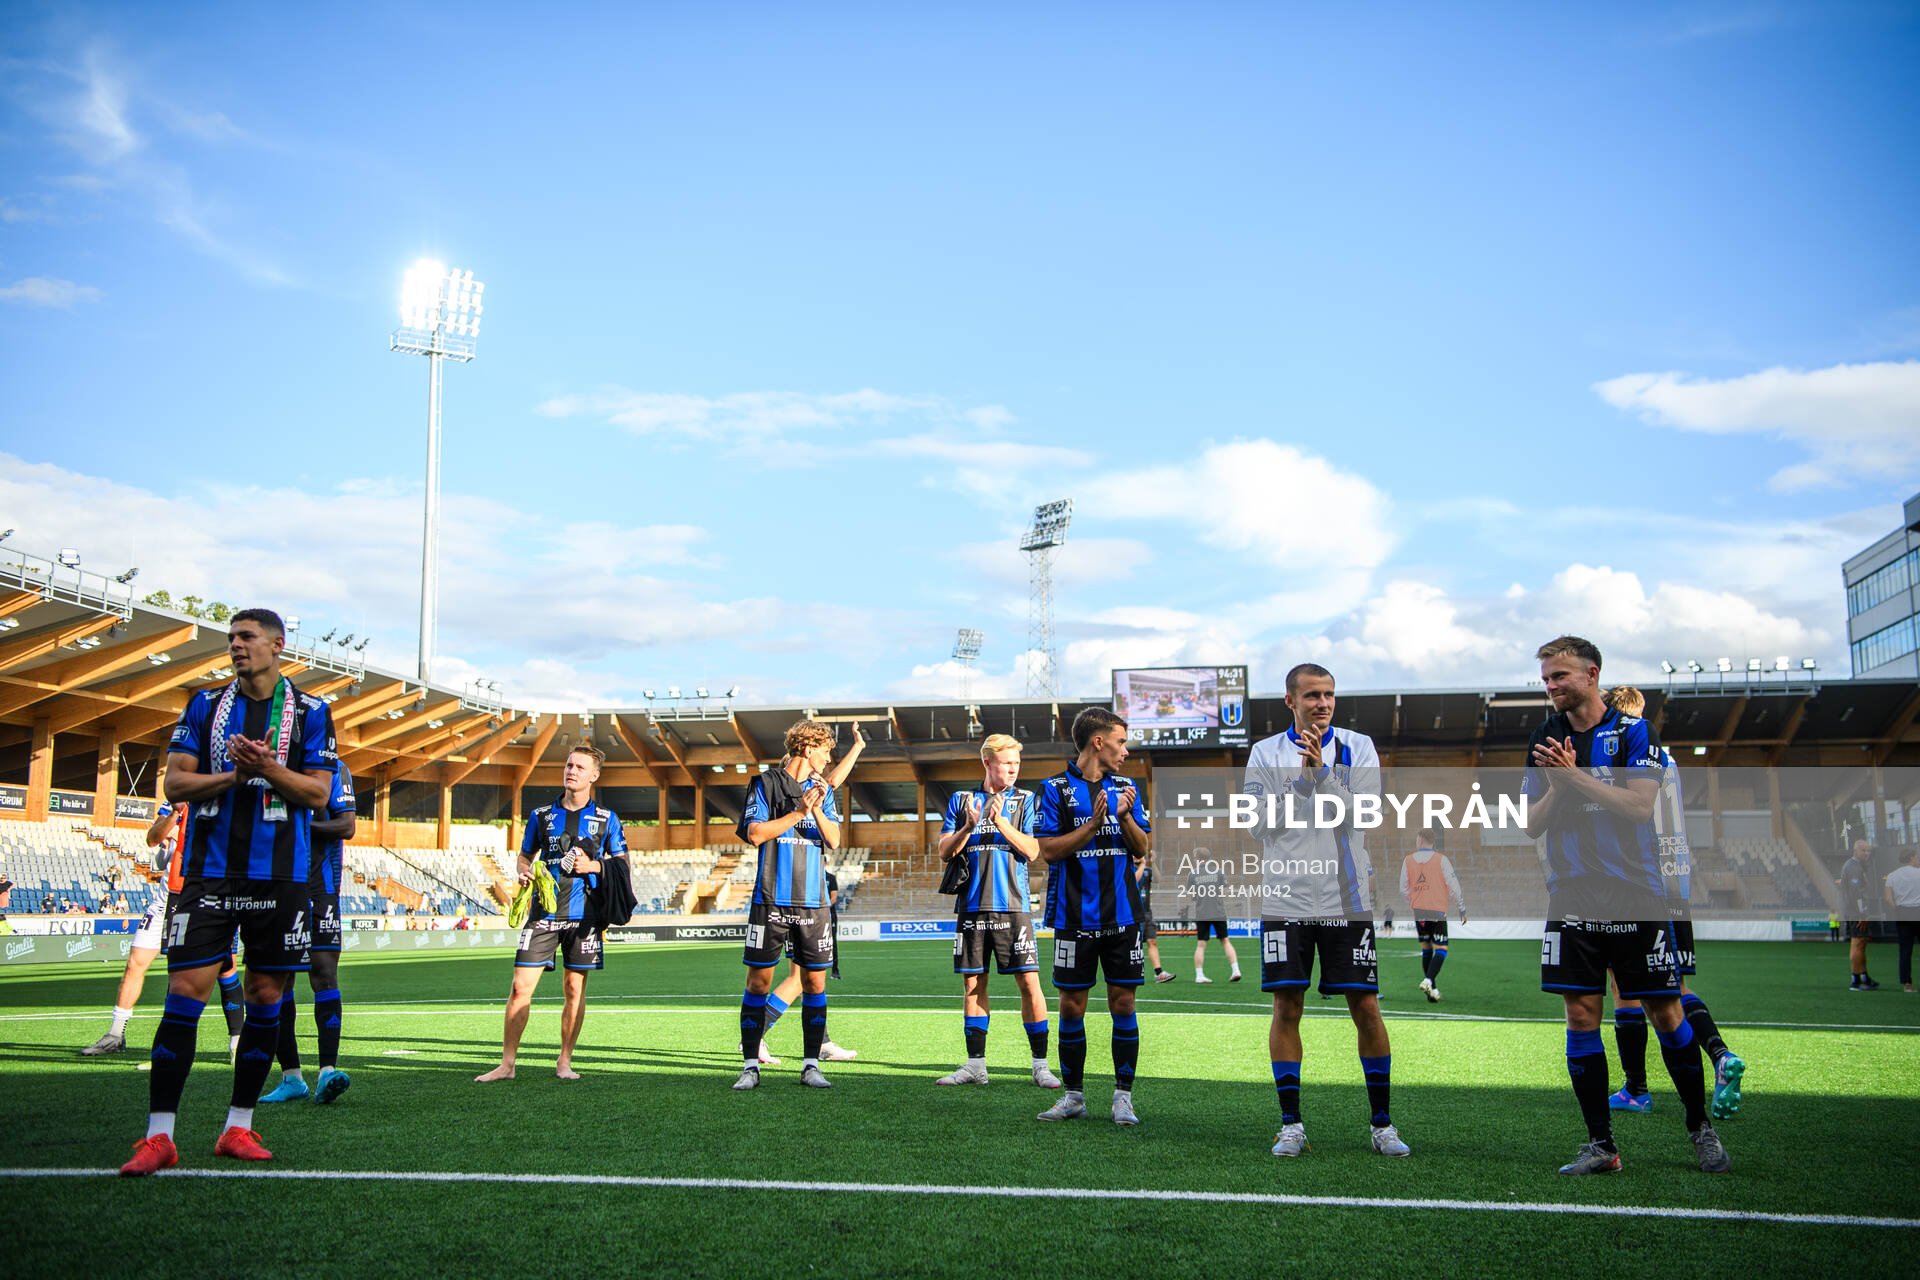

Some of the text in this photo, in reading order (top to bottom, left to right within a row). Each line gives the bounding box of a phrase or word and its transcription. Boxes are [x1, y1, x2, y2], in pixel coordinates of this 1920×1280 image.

[1218, 668, 1244, 678] 94:31
[1152, 730, 1159, 740] 3
[1173, 729, 1180, 740] 1
[1188, 728, 1208, 739] KFF
[1076, 848, 1127, 858] TOYO TIRES
[225, 900, 277, 910] BILFORUM
[49, 920, 92, 935] ESAB
[1585, 923, 1638, 934] BILFORUM
